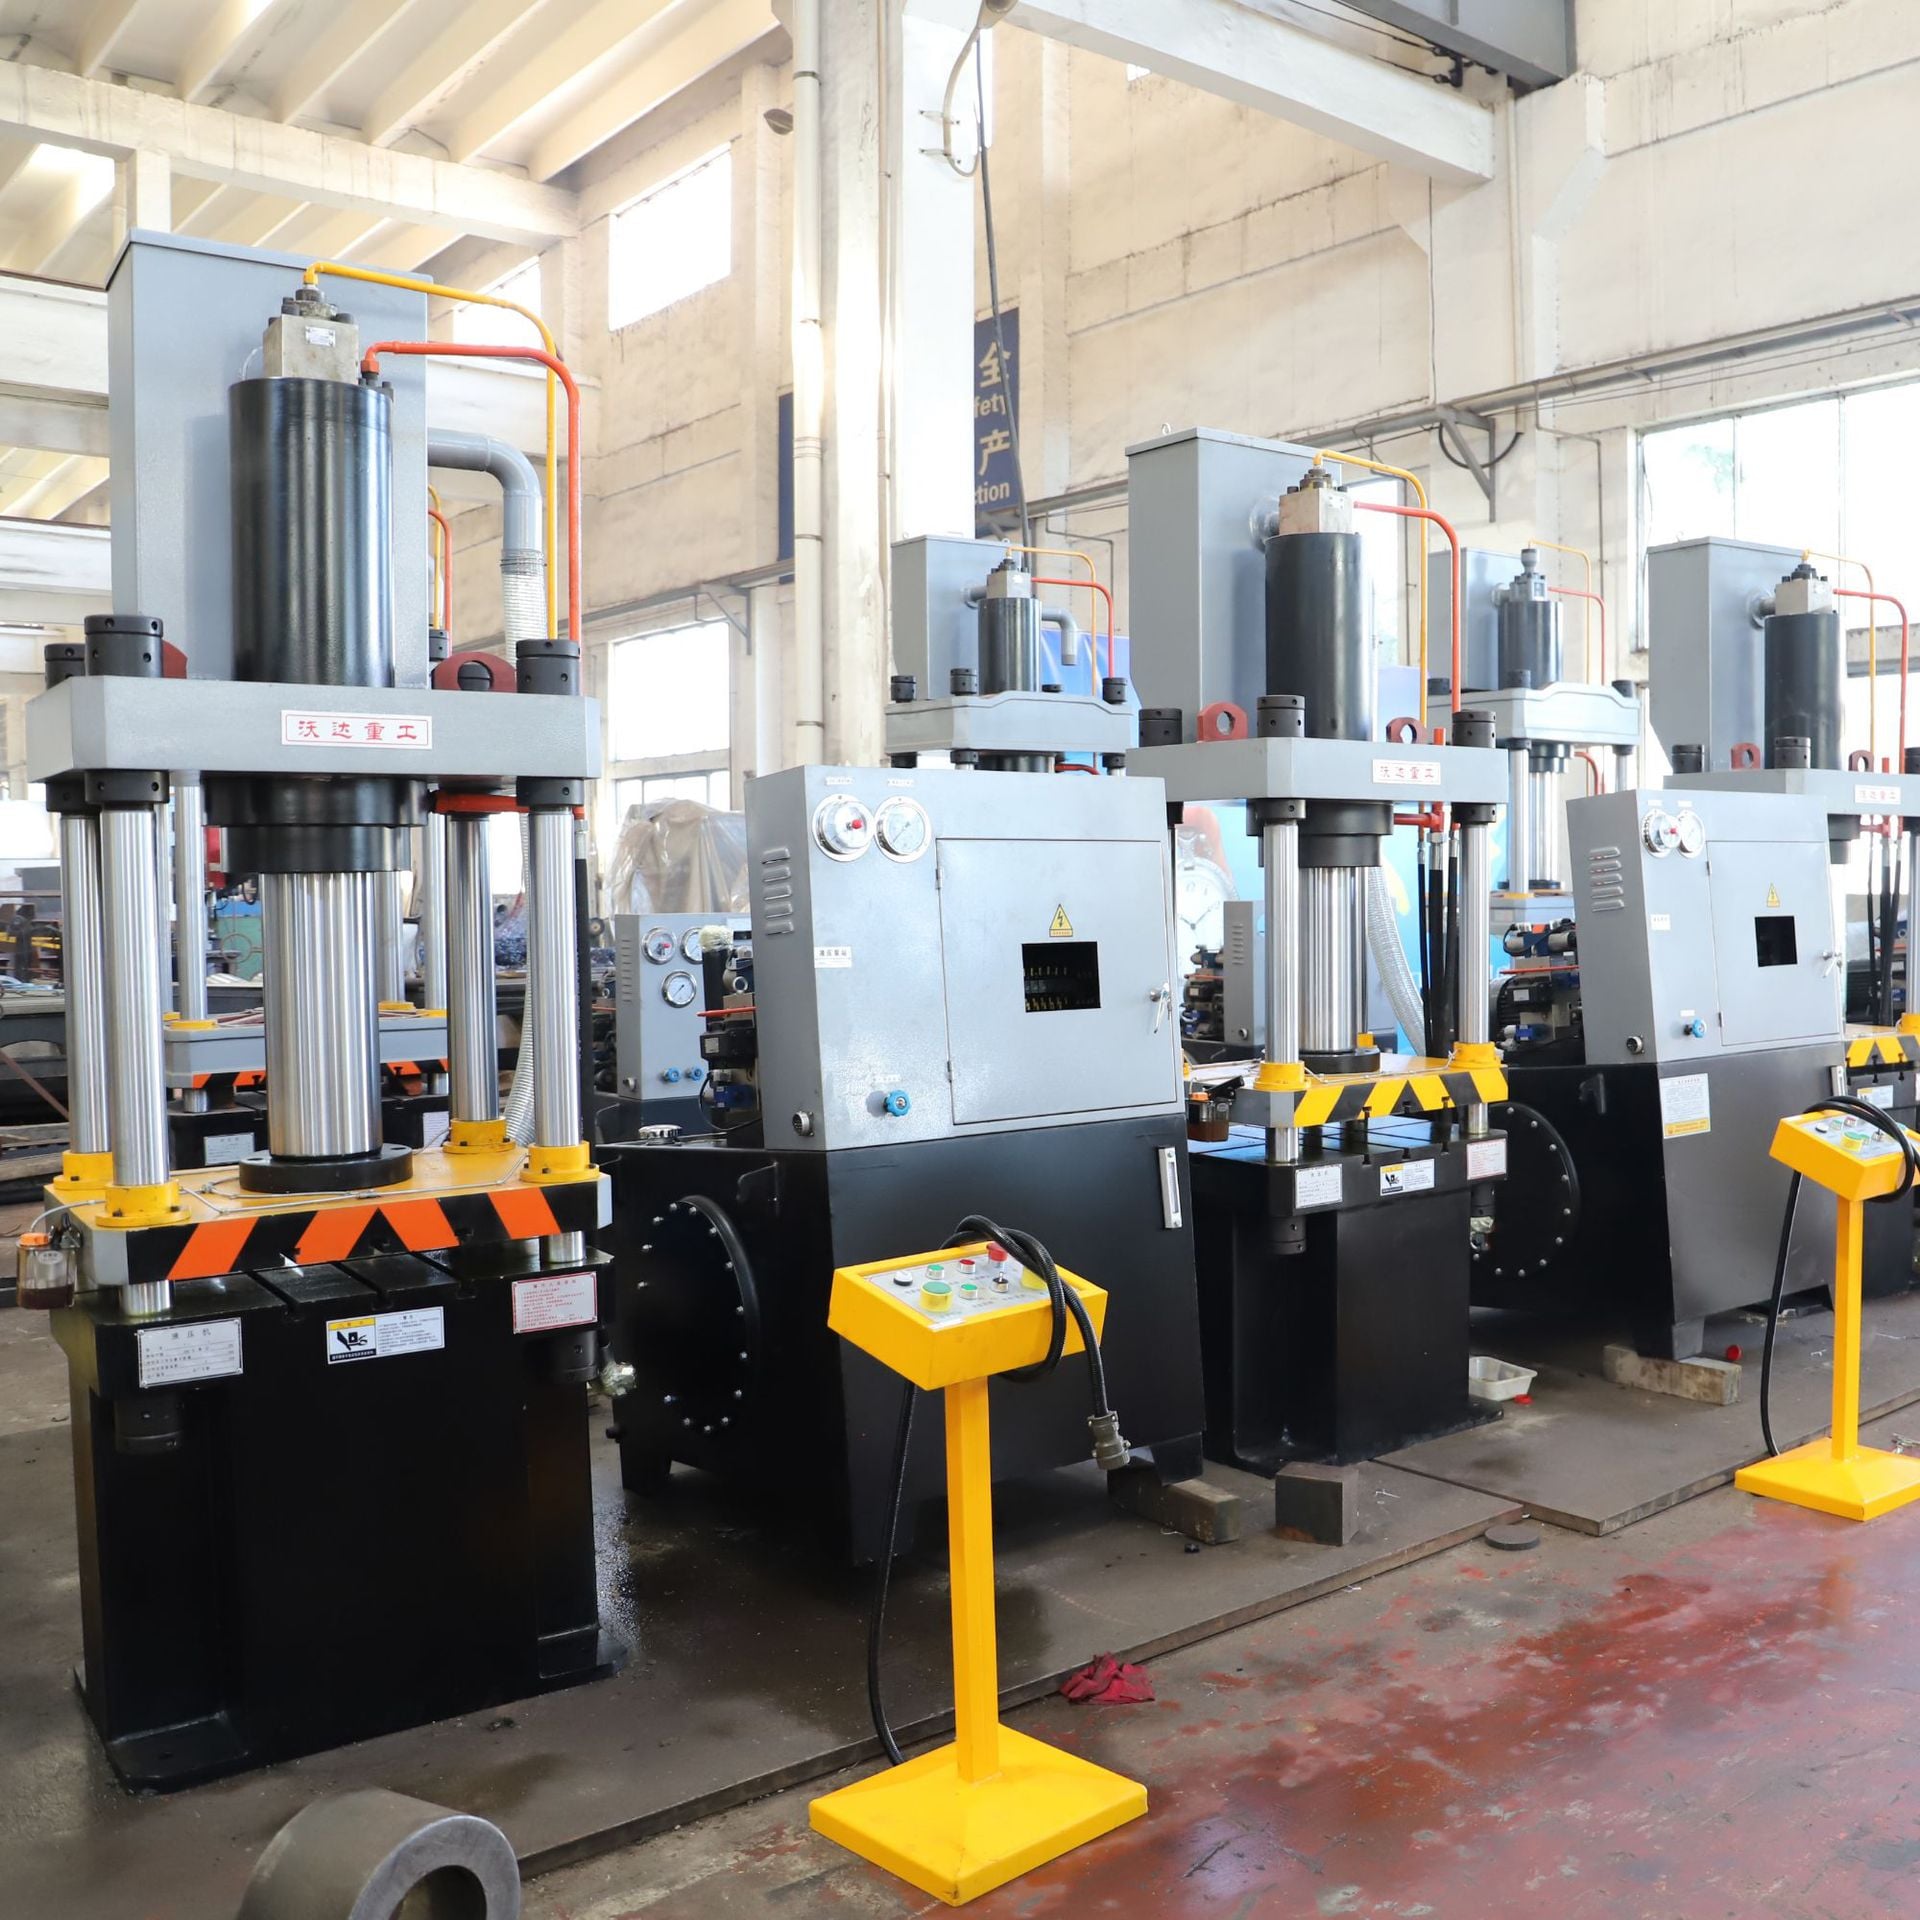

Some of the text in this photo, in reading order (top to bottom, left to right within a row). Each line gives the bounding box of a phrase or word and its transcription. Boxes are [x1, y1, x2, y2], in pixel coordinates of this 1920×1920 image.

[979, 428, 1011, 476] 产
[298, 720, 417, 741] 沃达重工
